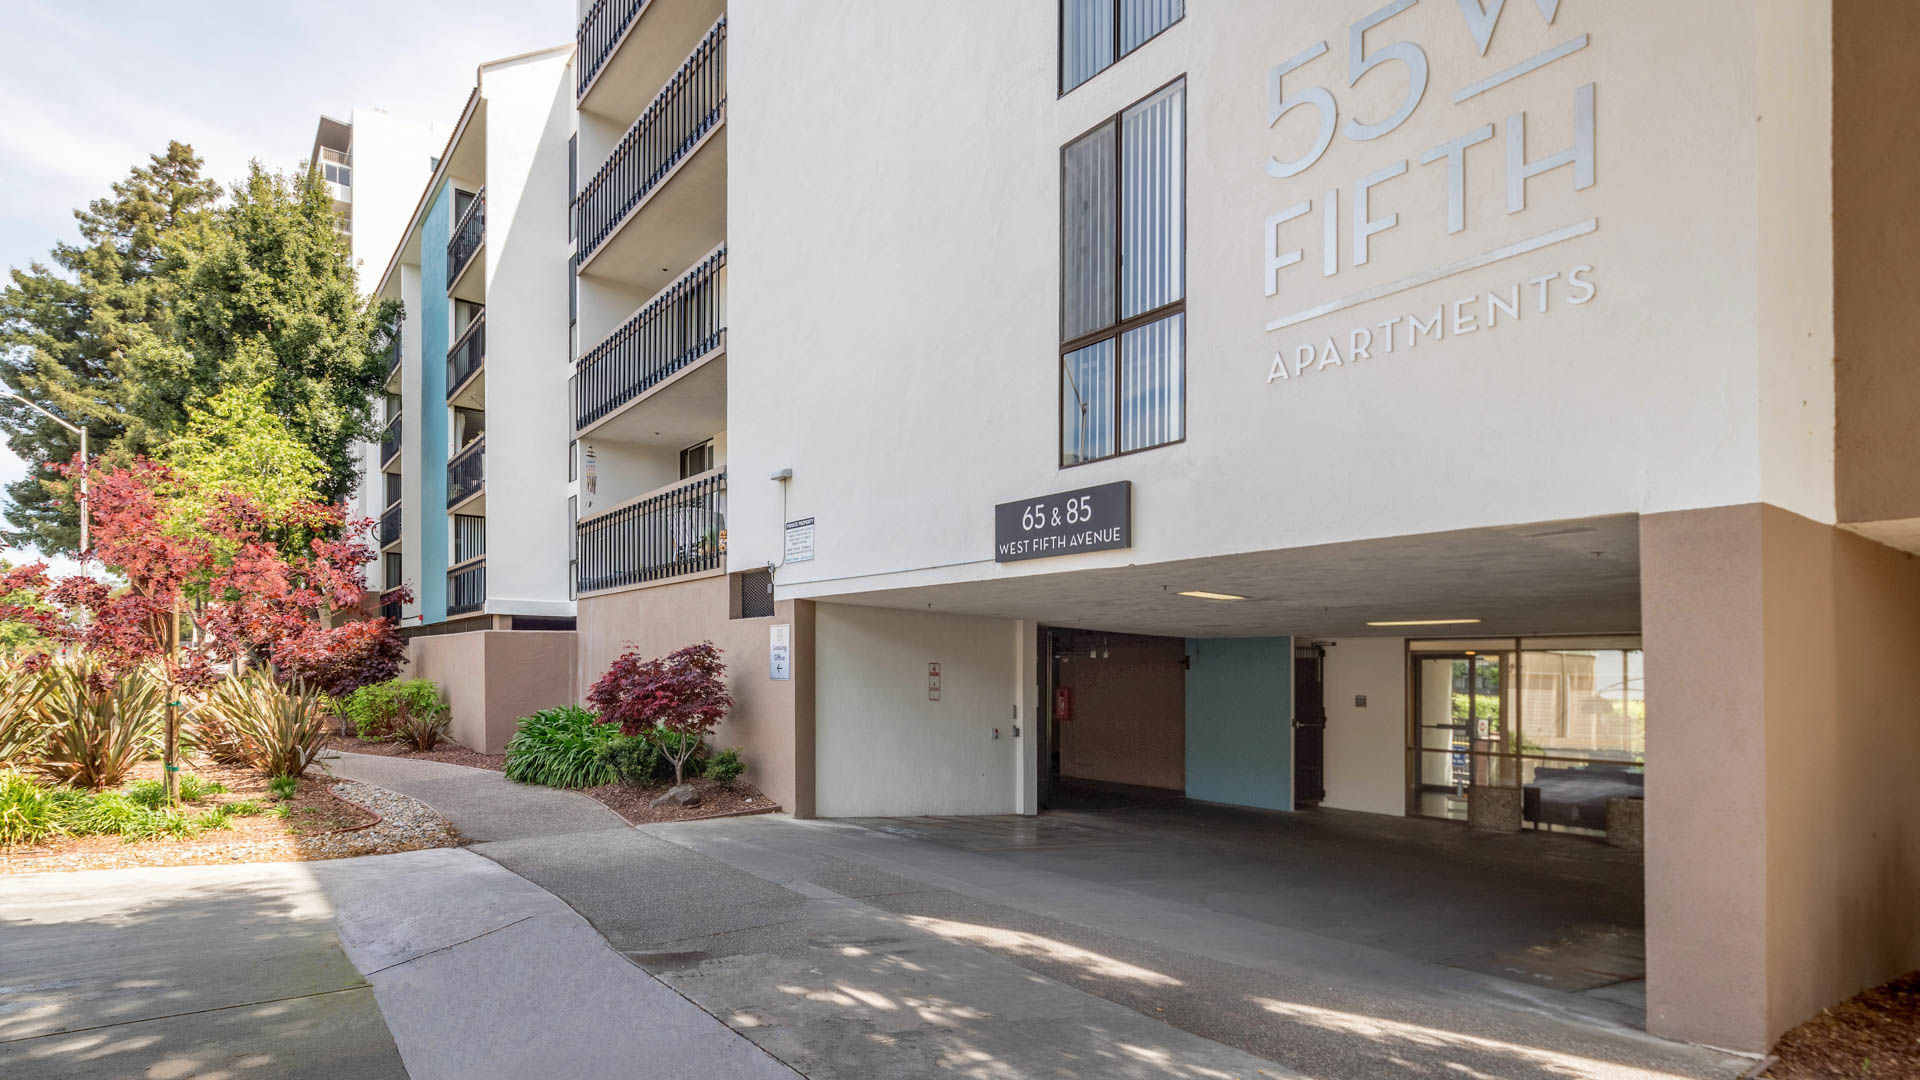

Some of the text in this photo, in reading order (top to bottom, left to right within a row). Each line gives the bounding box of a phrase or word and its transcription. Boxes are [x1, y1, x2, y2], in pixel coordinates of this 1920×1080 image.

[1264, 81, 1597, 298] FIFTH
[1265, 264, 1597, 384] APARTMENTS
[1022, 495, 1092, 531] 65 & 85
[999, 527, 1121, 555] WEST FIFTH AVENUE
[773, 644, 787, 652] Leasing
[774, 653, 785, 661] Office
